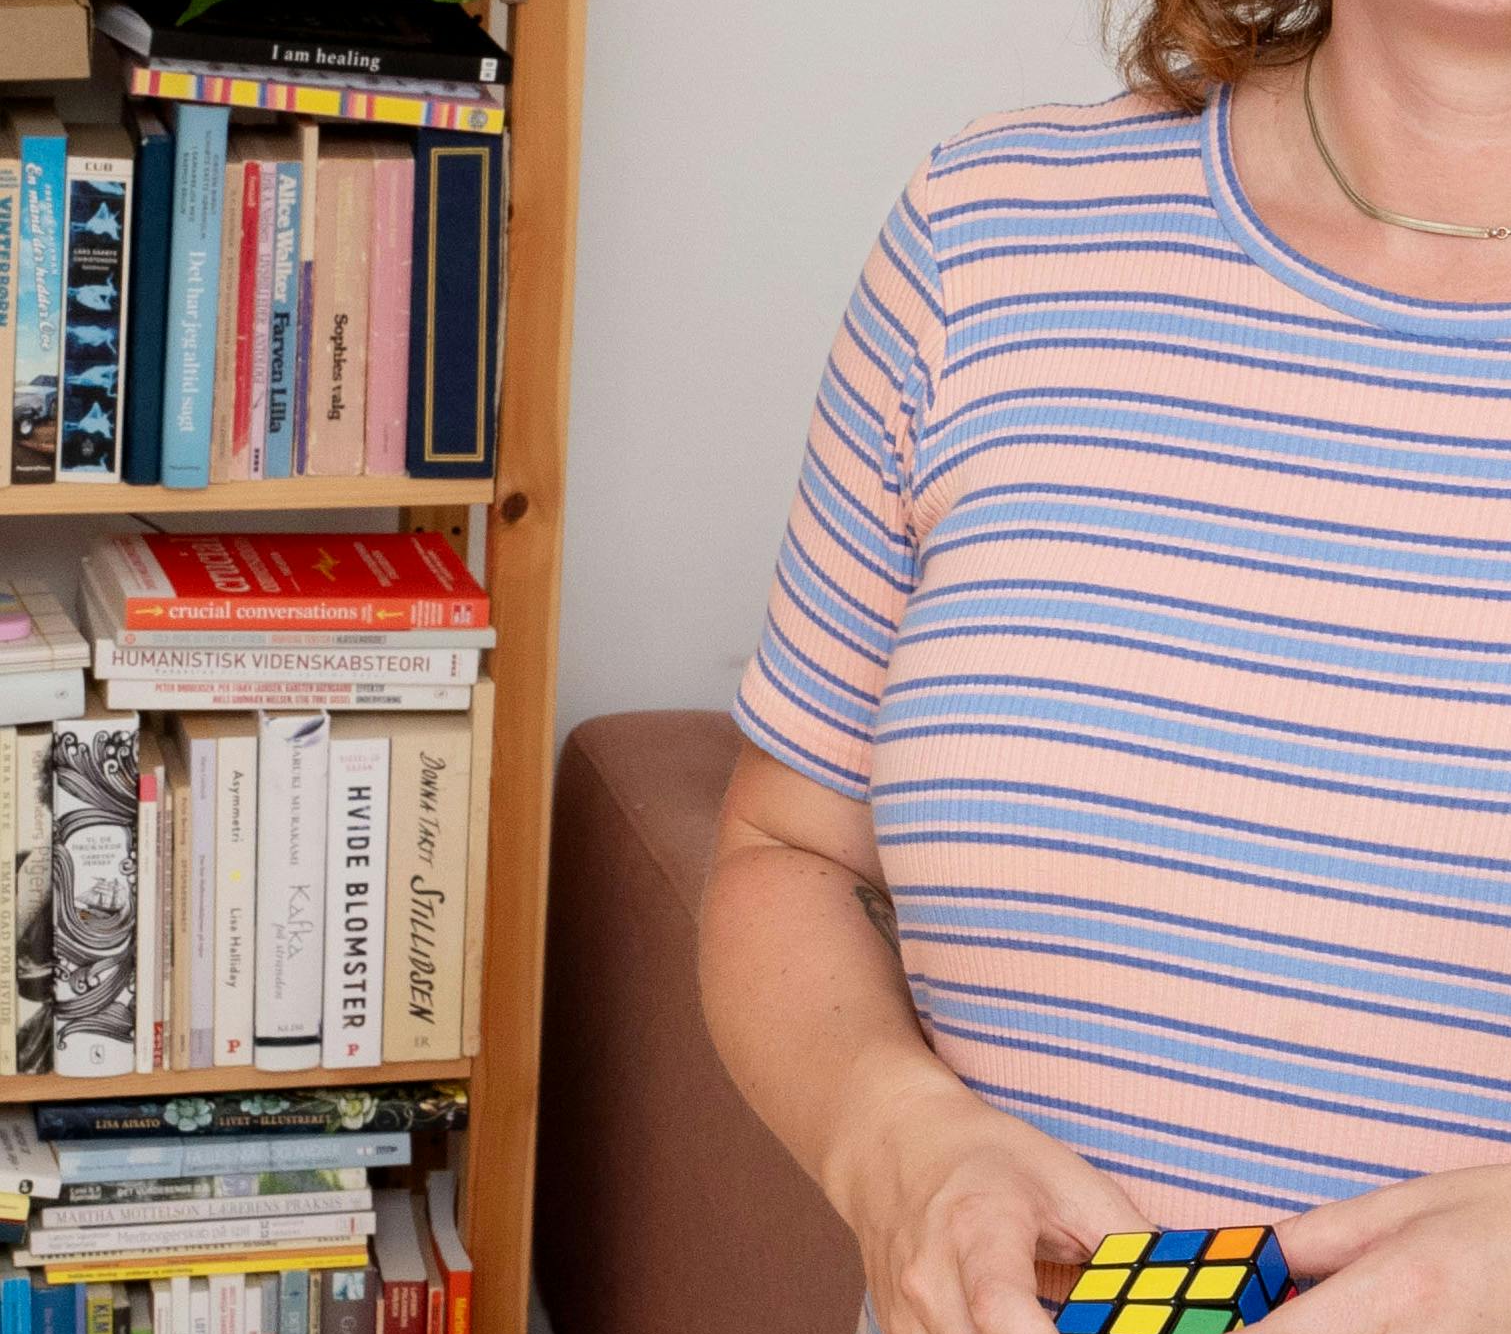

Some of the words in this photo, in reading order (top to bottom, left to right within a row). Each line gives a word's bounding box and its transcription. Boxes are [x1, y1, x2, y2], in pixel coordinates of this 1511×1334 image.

[272, 45, 279, 60] I
[284, 50, 311, 62] am
[317, 48, 381, 72] healing
[26, 162, 43, 185] En
[29, 190, 46, 235] mand
[275, 174, 297, 227] Alice
[33, 238, 48, 262] der
[187, 251, 205, 285] Det
[274, 229, 295, 304] Walker
[36, 267, 51, 316] hedder
[186, 288, 203, 319] har
[180, 321, 200, 348] jeg
[271, 312, 290, 383] Farven
[330, 314, 349, 381] Sophies
[181, 351, 200, 393] altid
[177, 396, 198, 432] sagt
[269, 387, 287, 433] Lilla
[327, 385, 345, 420] valg
[168, 602, 231, 620] crucial
[236, 603, 358, 620] conversations
[112, 651, 246, 669] HUMANISTISK
[252, 654, 431, 672] VIDENSKABSTEORI
[419, 751, 447, 814] DONNA
[229, 770, 243, 843] Asymmetri
[345, 785, 372, 869] HVIDE
[289, 795, 302, 866] MURAKAMI
[0, 860, 12, 906] EMMA
[0, 911, 12, 941] GAD
[229, 908, 242, 931] Lisa
[271, 924, 287, 940] på
[287, 883, 313, 959] Kafka
[225, 936, 242, 987] Halliday
[343, 883, 370, 1029] BLOMSTER
[407, 874, 446, 1025] STILLIDSEN
[274, 944, 288, 999] stranden
[96, 1119, 120, 1130] LISA
[122, 1117, 160, 1129] AISATO
[219, 1115, 251, 1127] LIVET
[55, 1208, 114, 1225] MARTHA
[120, 1203, 199, 1221] MOTTELSON
[285, 1196, 343, 1213] PRAKSIS
[93, 1304, 111, 1333] KLM
